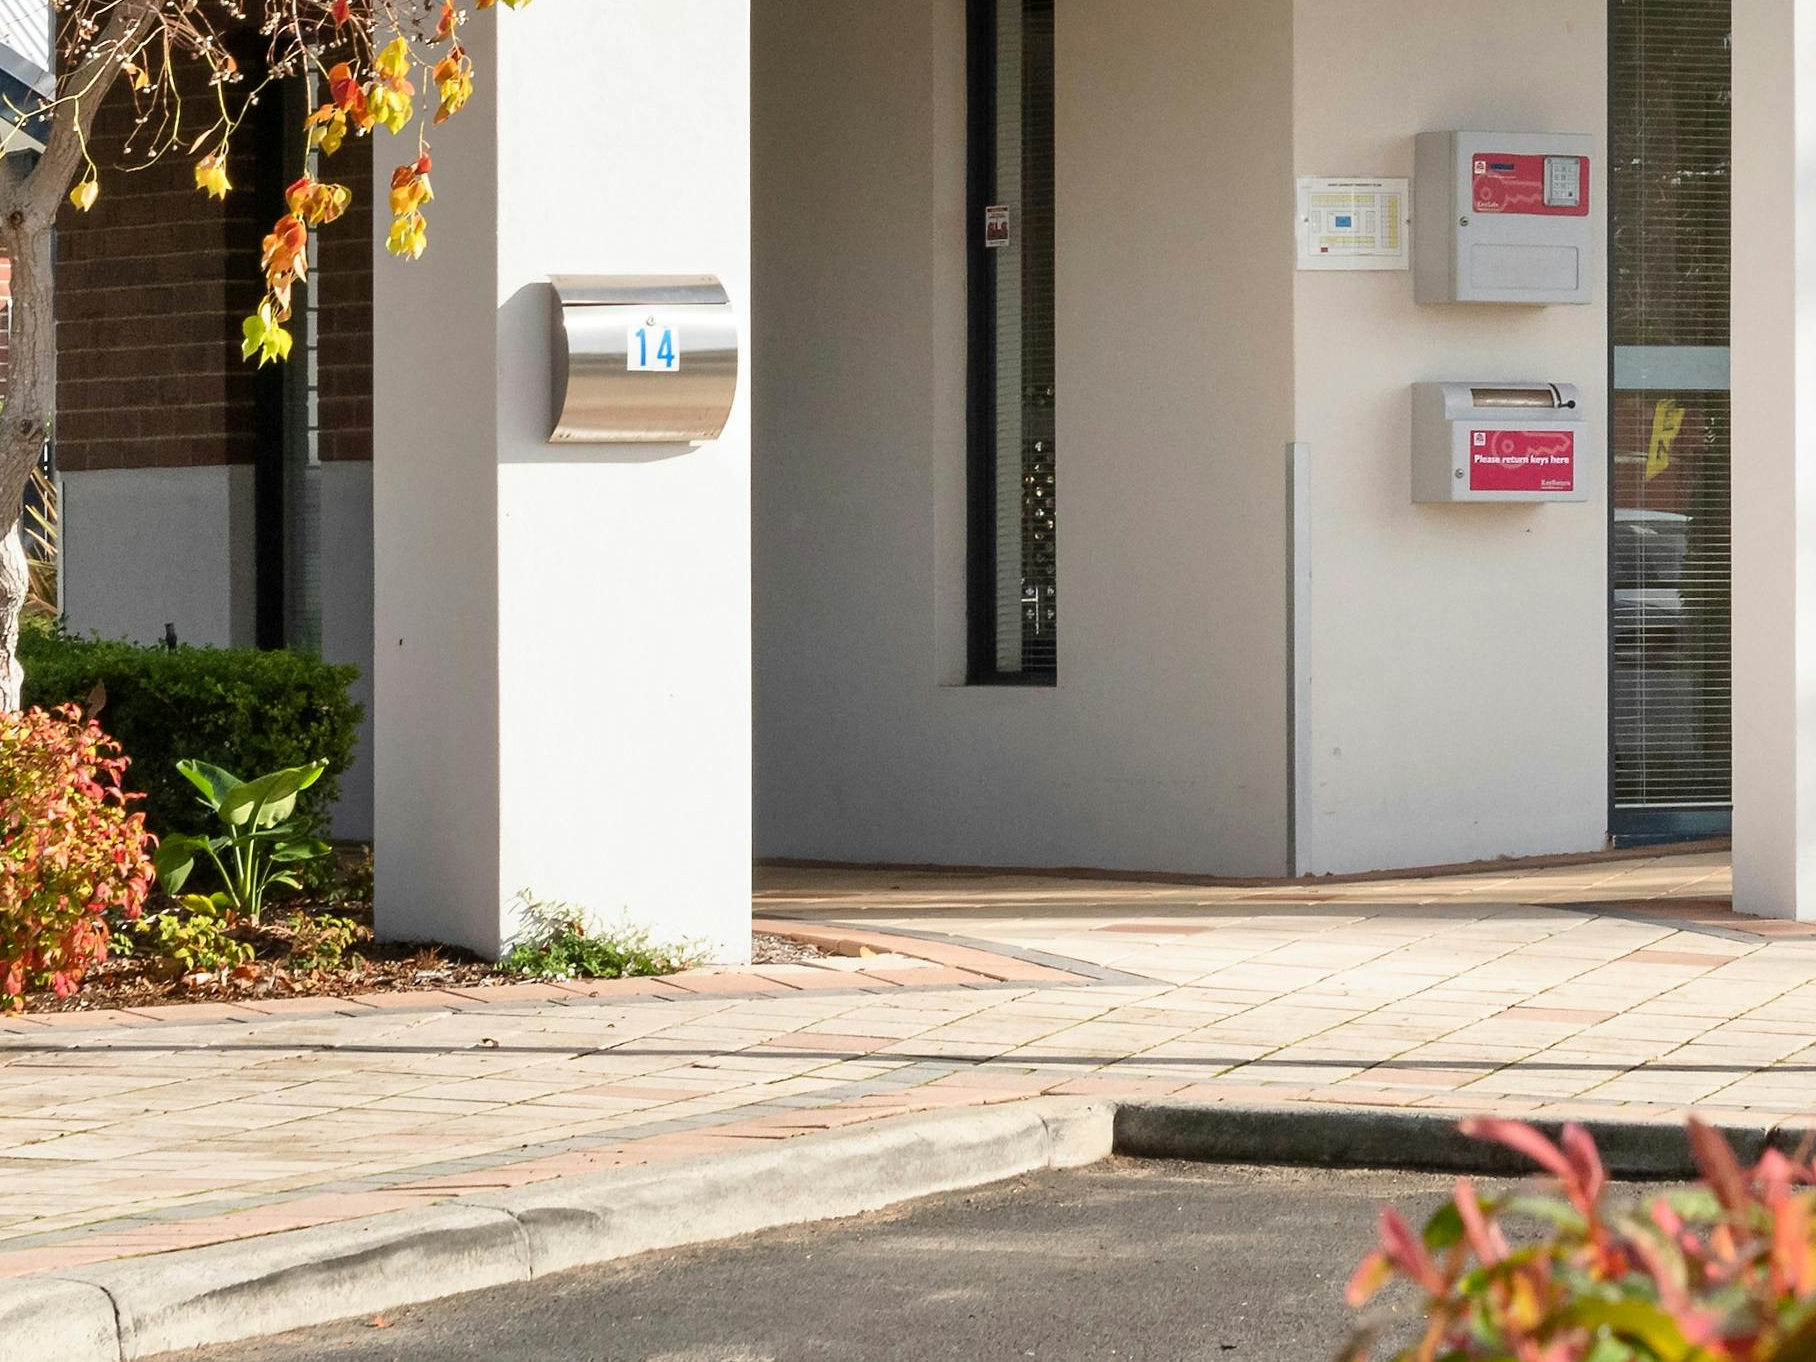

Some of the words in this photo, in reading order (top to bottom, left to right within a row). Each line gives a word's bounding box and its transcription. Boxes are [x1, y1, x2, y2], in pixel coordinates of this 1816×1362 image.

[635, 328, 675, 368] 14
[1474, 454, 1500, 464] Please
[1502, 456, 1529, 464] return
[1530, 455, 1549, 466] keys
[1550, 455, 1569, 464] here
